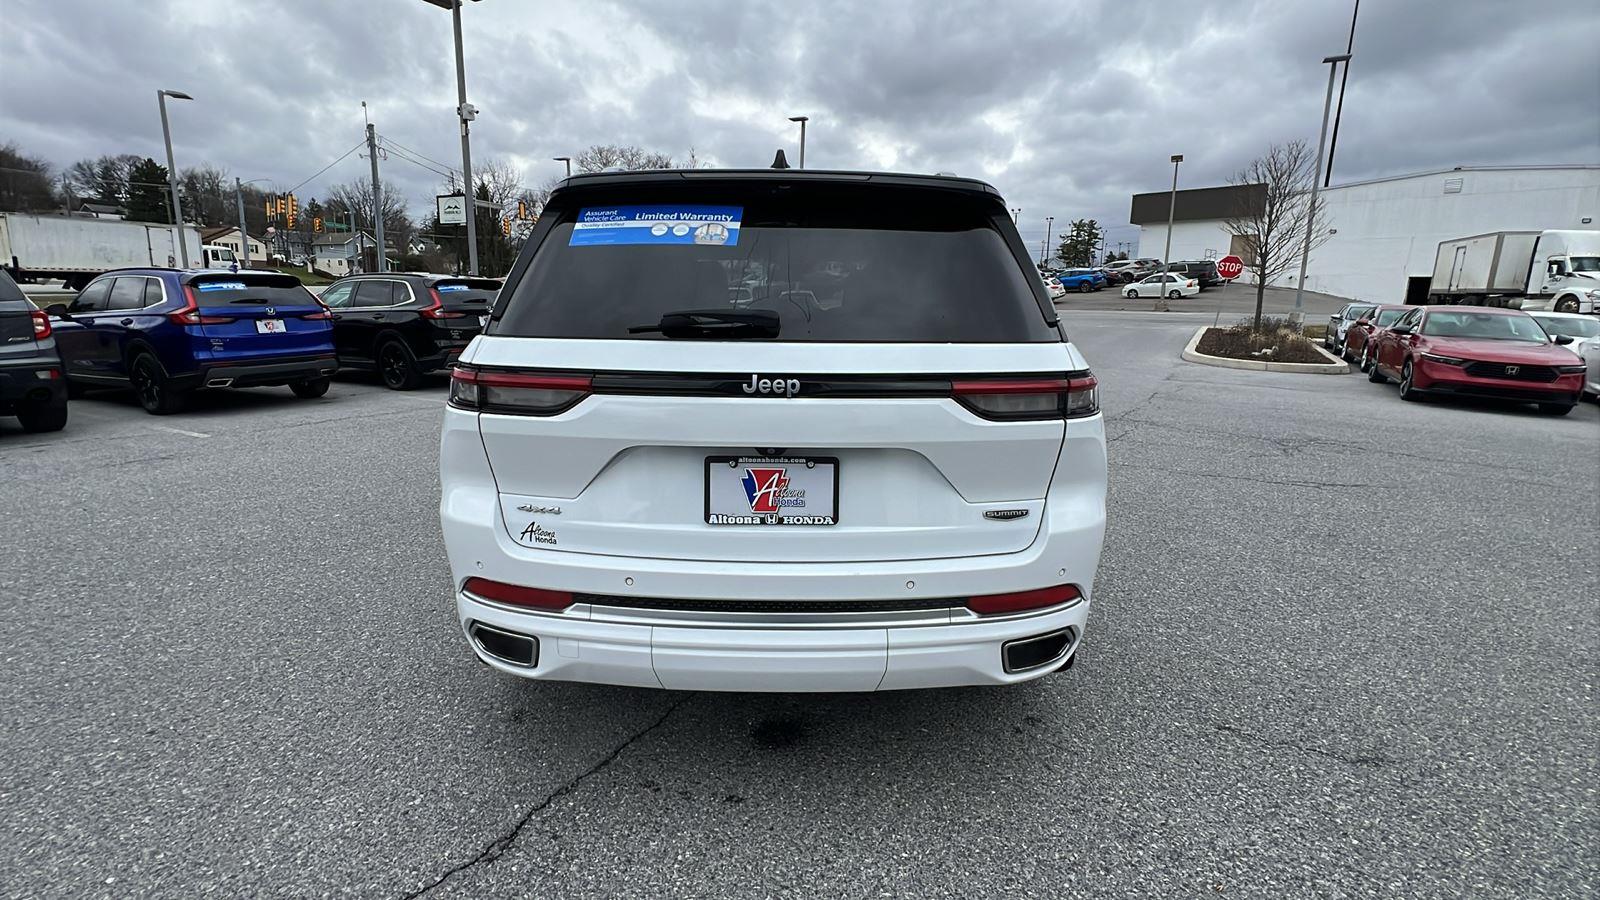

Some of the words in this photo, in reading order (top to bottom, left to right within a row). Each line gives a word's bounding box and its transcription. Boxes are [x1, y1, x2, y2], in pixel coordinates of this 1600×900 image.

[635, 212, 678, 220] Limited
[679, 212, 733, 222] Warranty
[1218, 262, 1242, 272] STOP
[742, 374, 801, 398] Jeep
[753, 472, 806, 507] Altoona
[773, 497, 806, 507] Honda
[708, 514, 760, 524] Altoona
[783, 516, 834, 524] HONDA
[520, 521, 556, 542] Altoona
[535, 535, 557, 544] Honda
